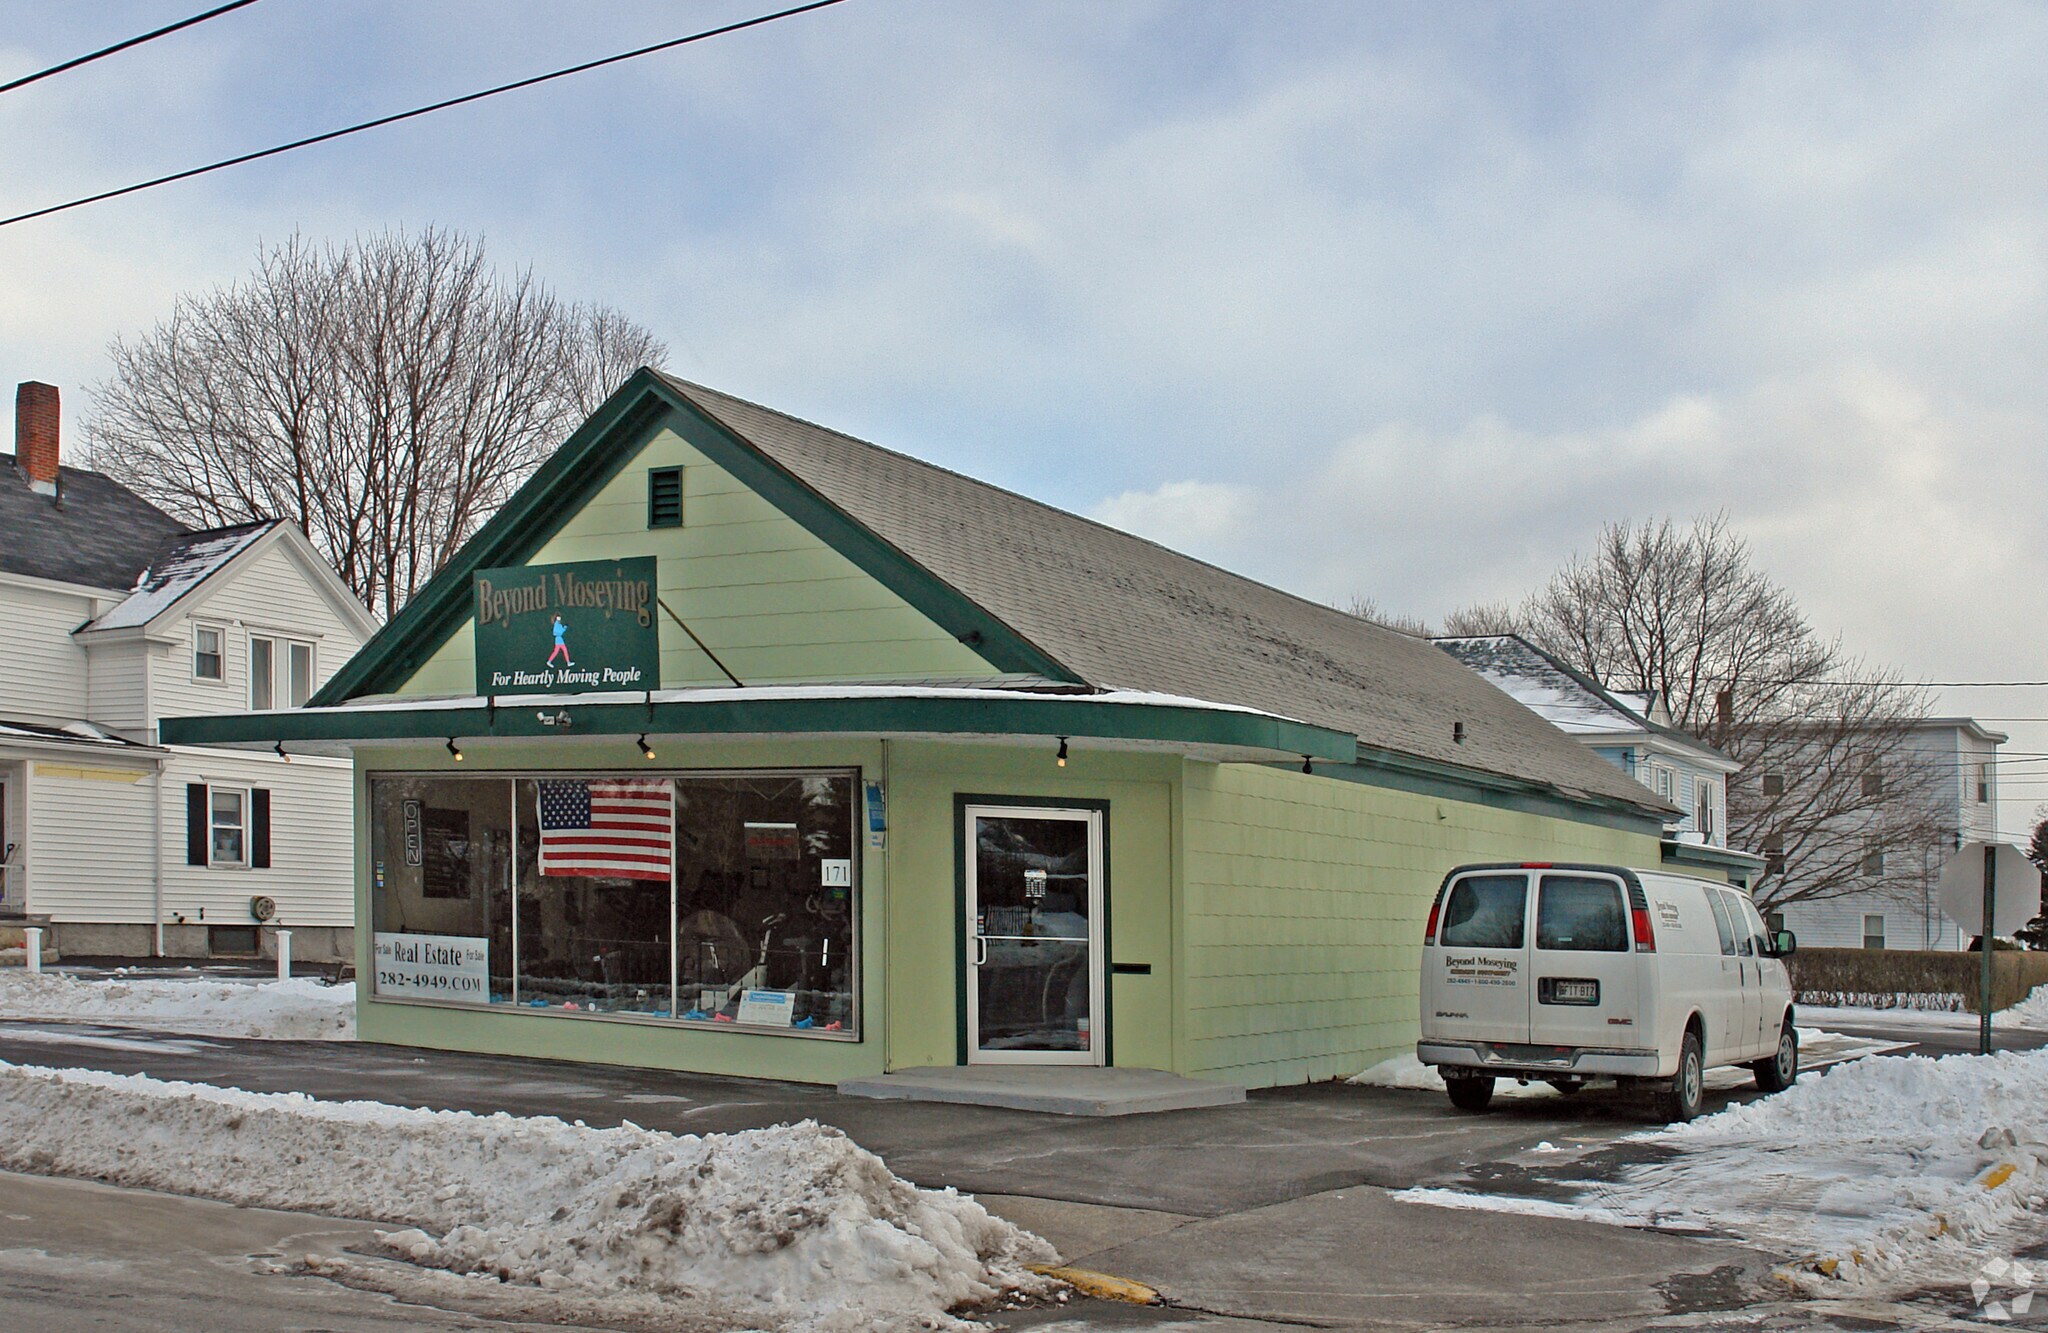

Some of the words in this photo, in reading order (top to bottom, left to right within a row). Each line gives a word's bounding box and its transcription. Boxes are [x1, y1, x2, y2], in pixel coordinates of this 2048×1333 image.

[479, 575, 547, 628] Beyond
[553, 568, 651, 628] Moseying
[492, 671, 512, 686] For
[513, 671, 554, 688] Heartly
[556, 669, 599, 686] Moving
[603, 666, 641, 683] People
[406, 804, 419, 862] OPEN
[826, 866, 846, 881] 171
[395, 941, 418, 963] Real
[425, 943, 462, 966] Estate
[1446, 956, 1475, 968] Beyond
[1477, 957, 1517, 972] Moseying
[380, 971, 481, 992] 282-4949.COM
[1580, 986, 1595, 997] BIZ
